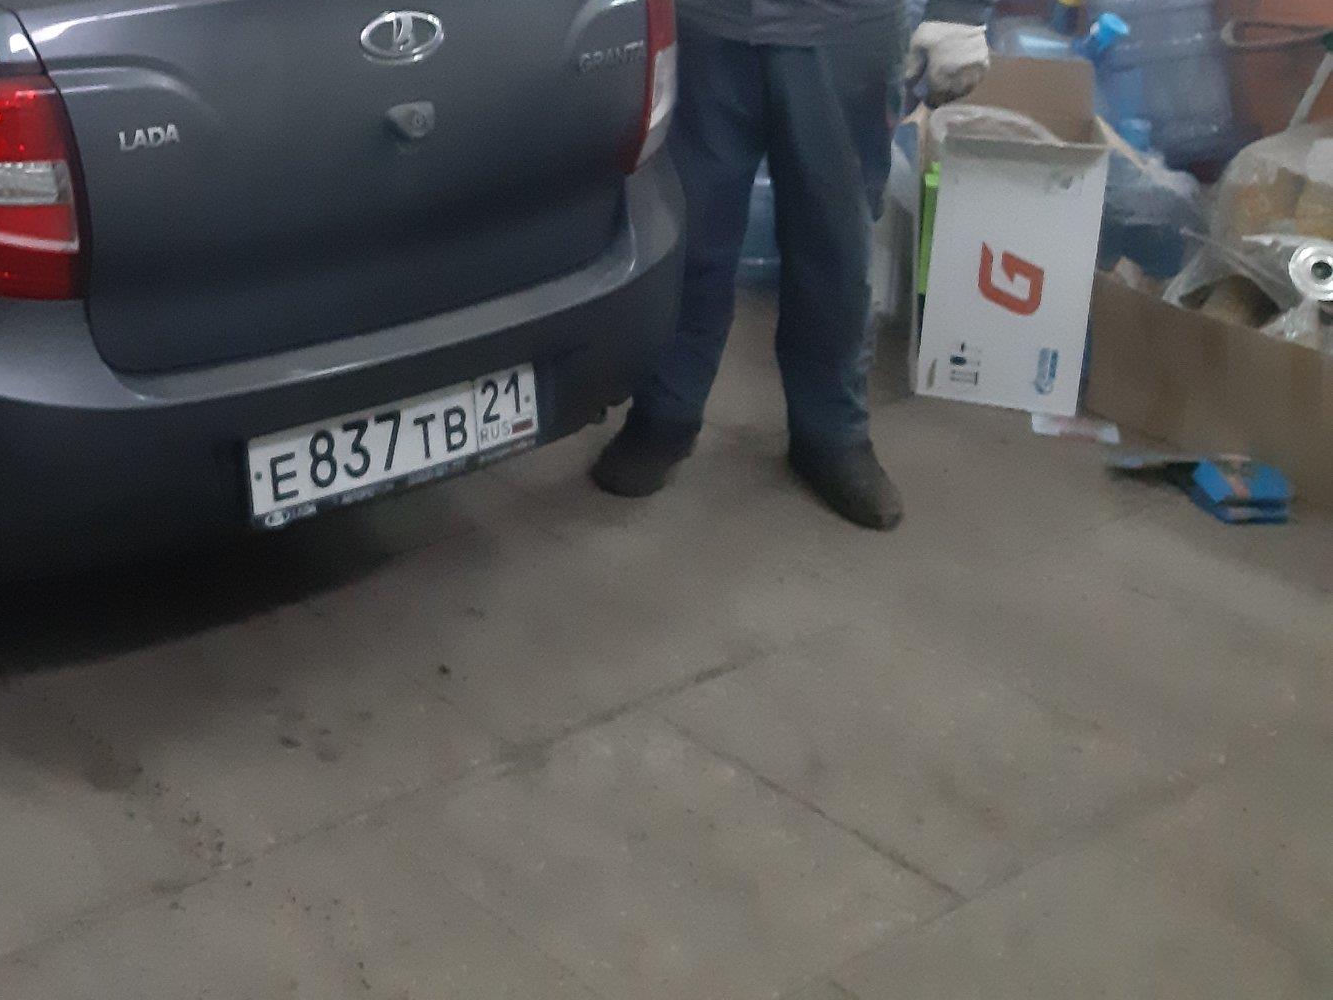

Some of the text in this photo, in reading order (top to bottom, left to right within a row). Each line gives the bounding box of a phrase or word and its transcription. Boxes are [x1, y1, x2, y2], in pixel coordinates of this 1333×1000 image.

[119, 124, 180, 151] LADA
[269, 372, 521, 501] Е837ТВ 21
[479, 420, 513, 443] RUS
